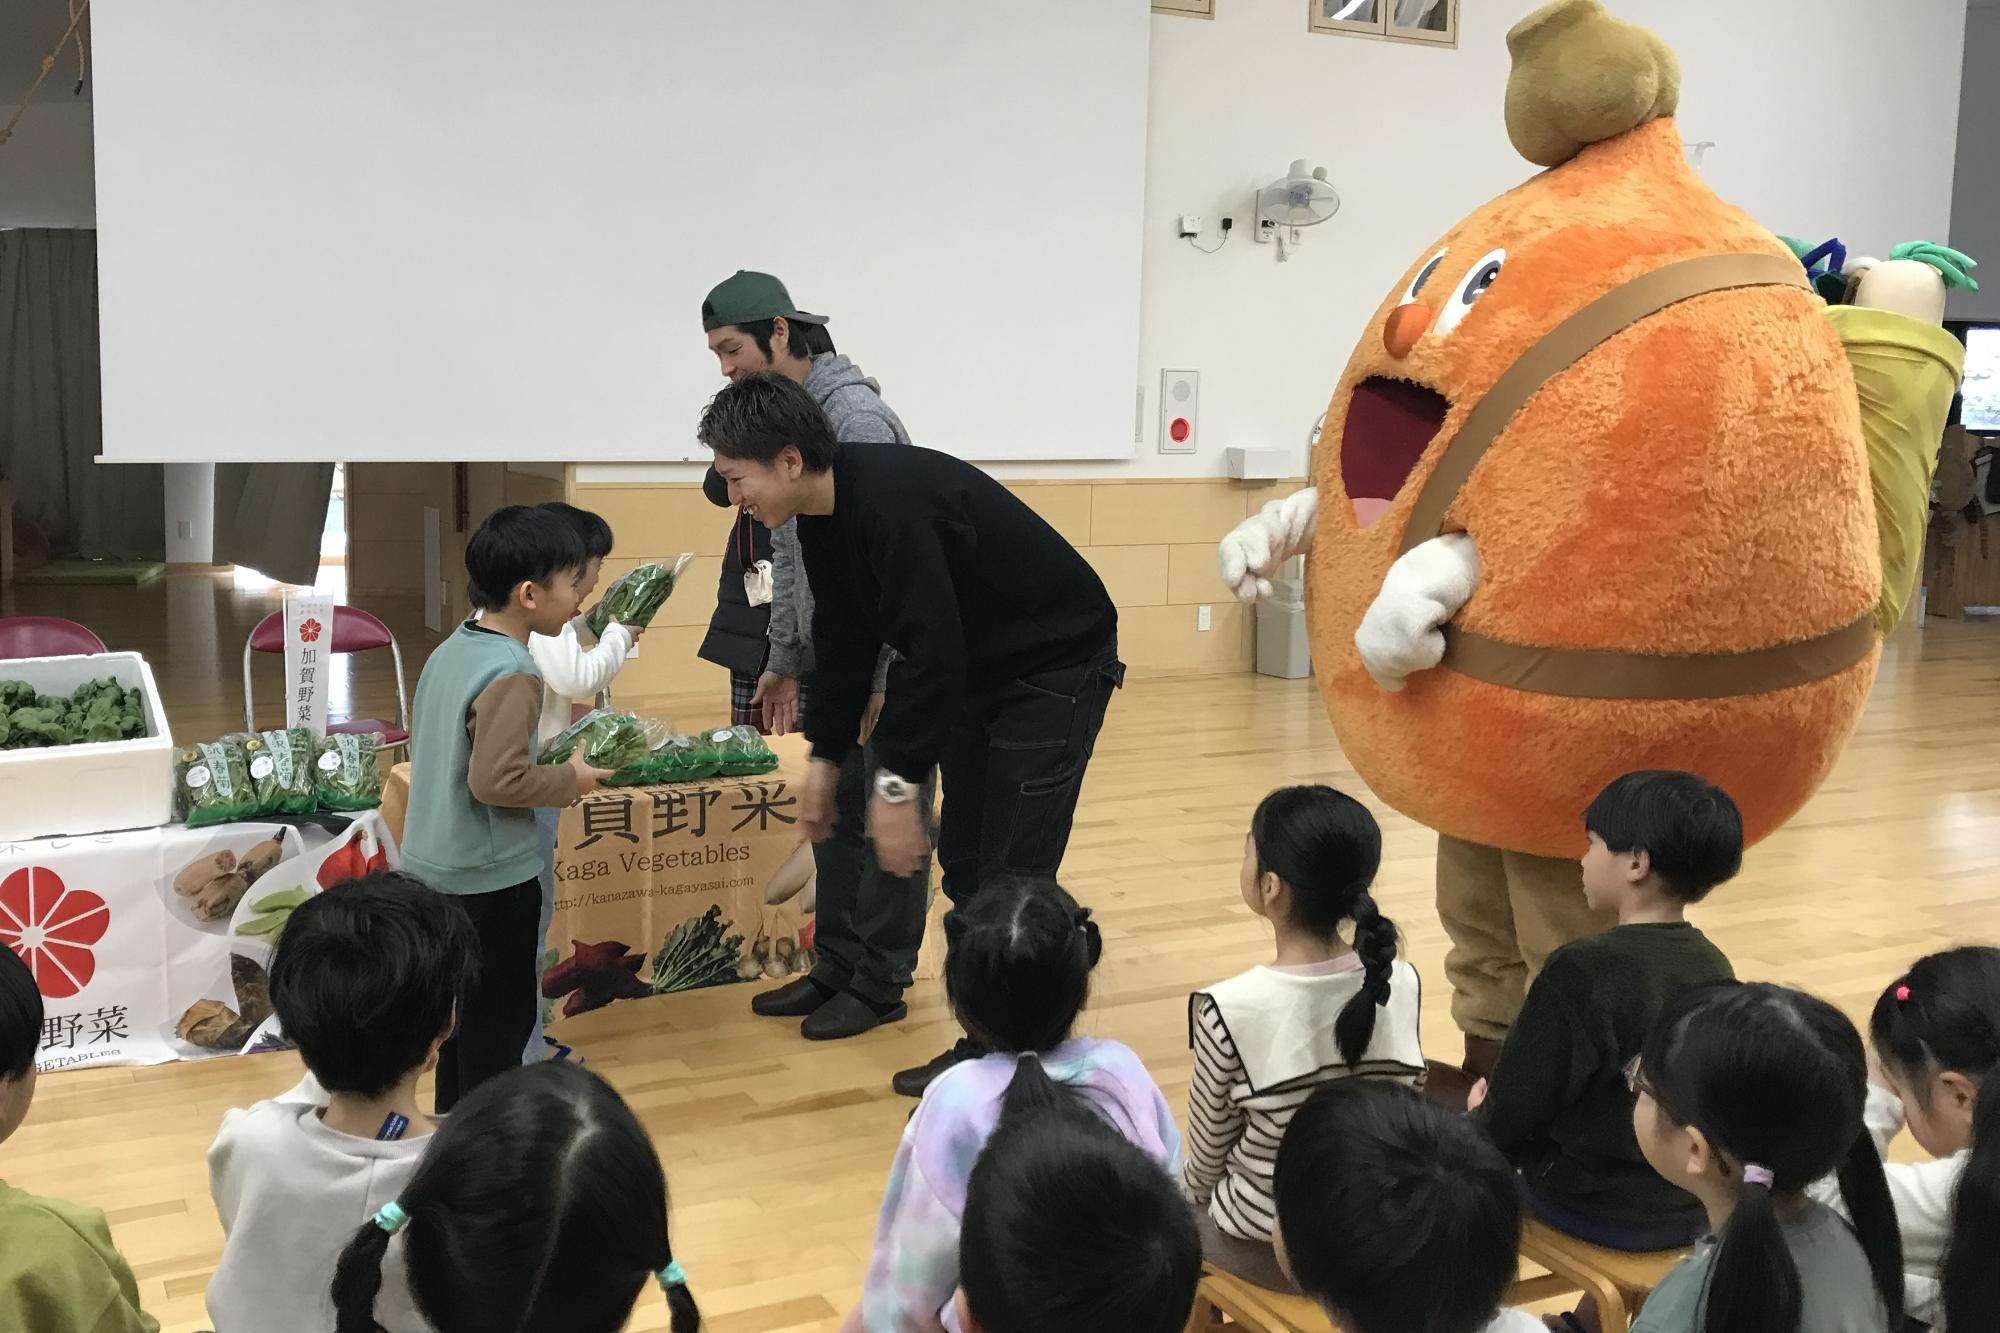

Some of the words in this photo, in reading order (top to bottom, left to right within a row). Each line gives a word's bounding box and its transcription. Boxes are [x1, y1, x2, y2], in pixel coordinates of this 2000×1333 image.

[296, 647, 317, 721] 加賀野菜
[554, 779, 798, 850] 賀野菜
[618, 843, 751, 872] Vegetables
